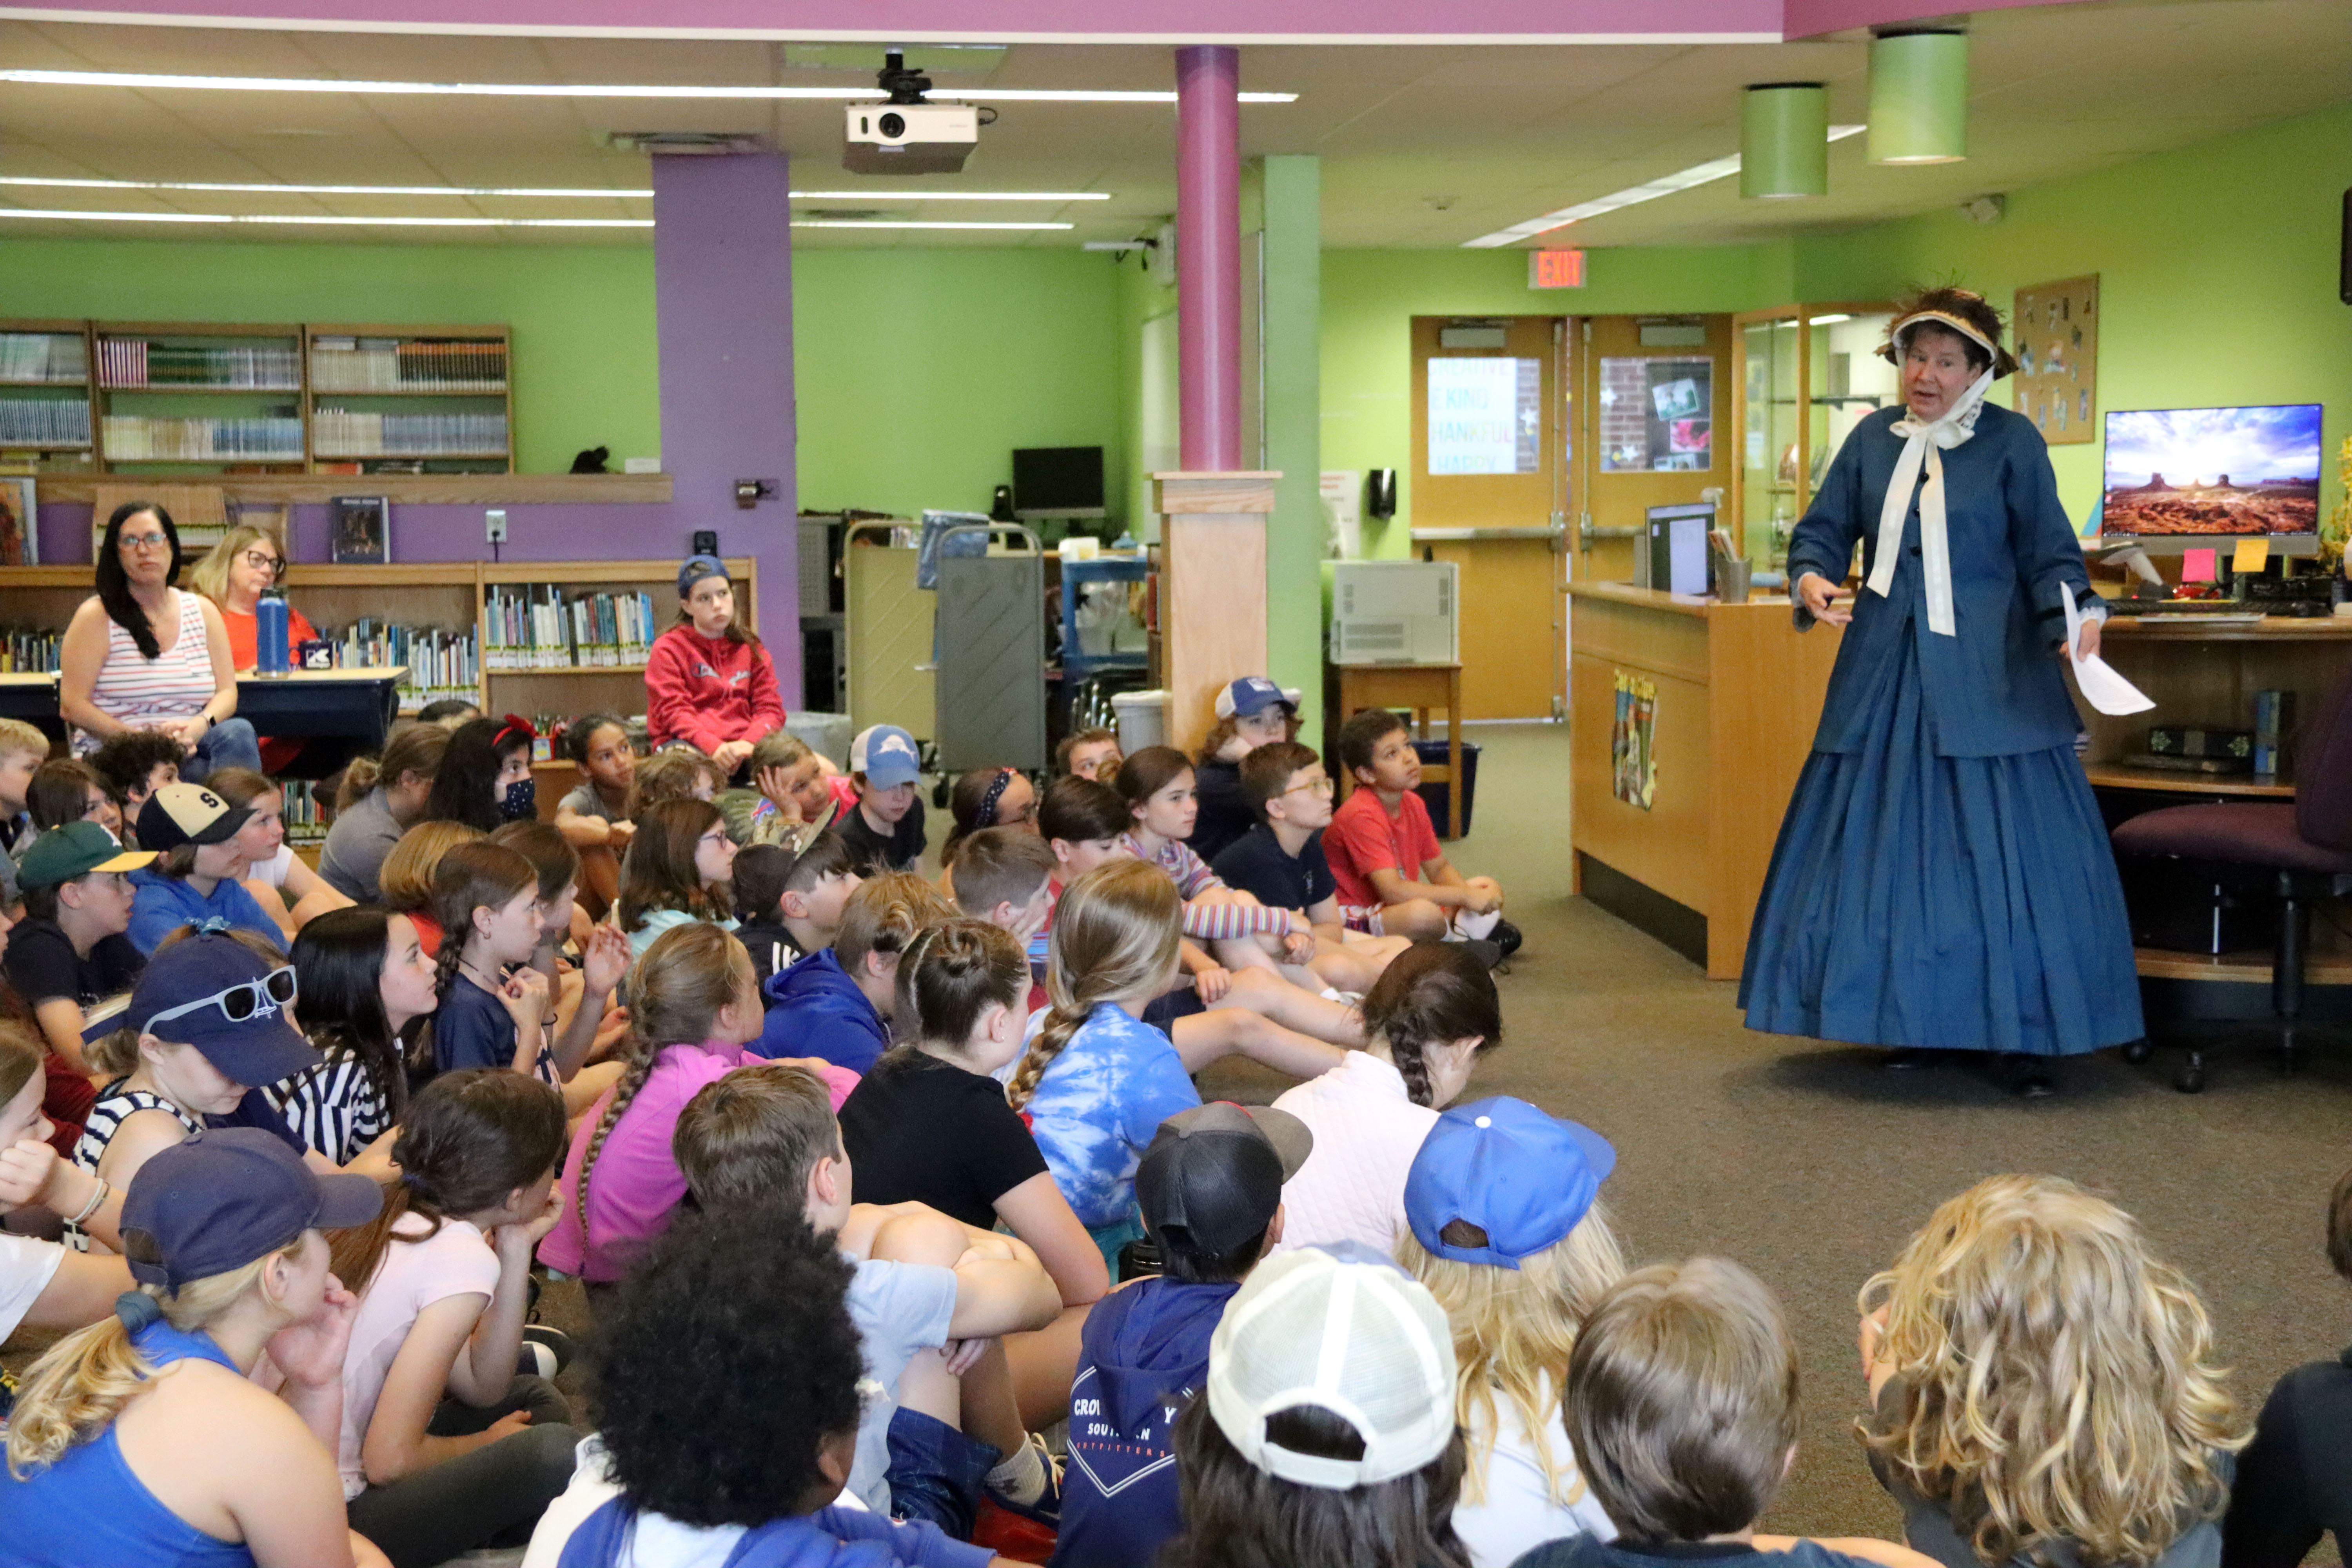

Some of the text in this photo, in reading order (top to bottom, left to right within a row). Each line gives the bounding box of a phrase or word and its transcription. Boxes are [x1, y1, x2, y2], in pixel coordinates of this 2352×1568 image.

[1538, 251, 1582, 287] EXIT
[1446, 387, 1489, 410] KIND
[1432, 421, 1512, 443] HANKFUL
[200, 792, 219, 808] S
[1074, 1399, 1100, 1416] CRO
[1087, 1423, 1151, 1441] SOUN
[1076, 1442, 1165, 1458] OUTFITTERS
